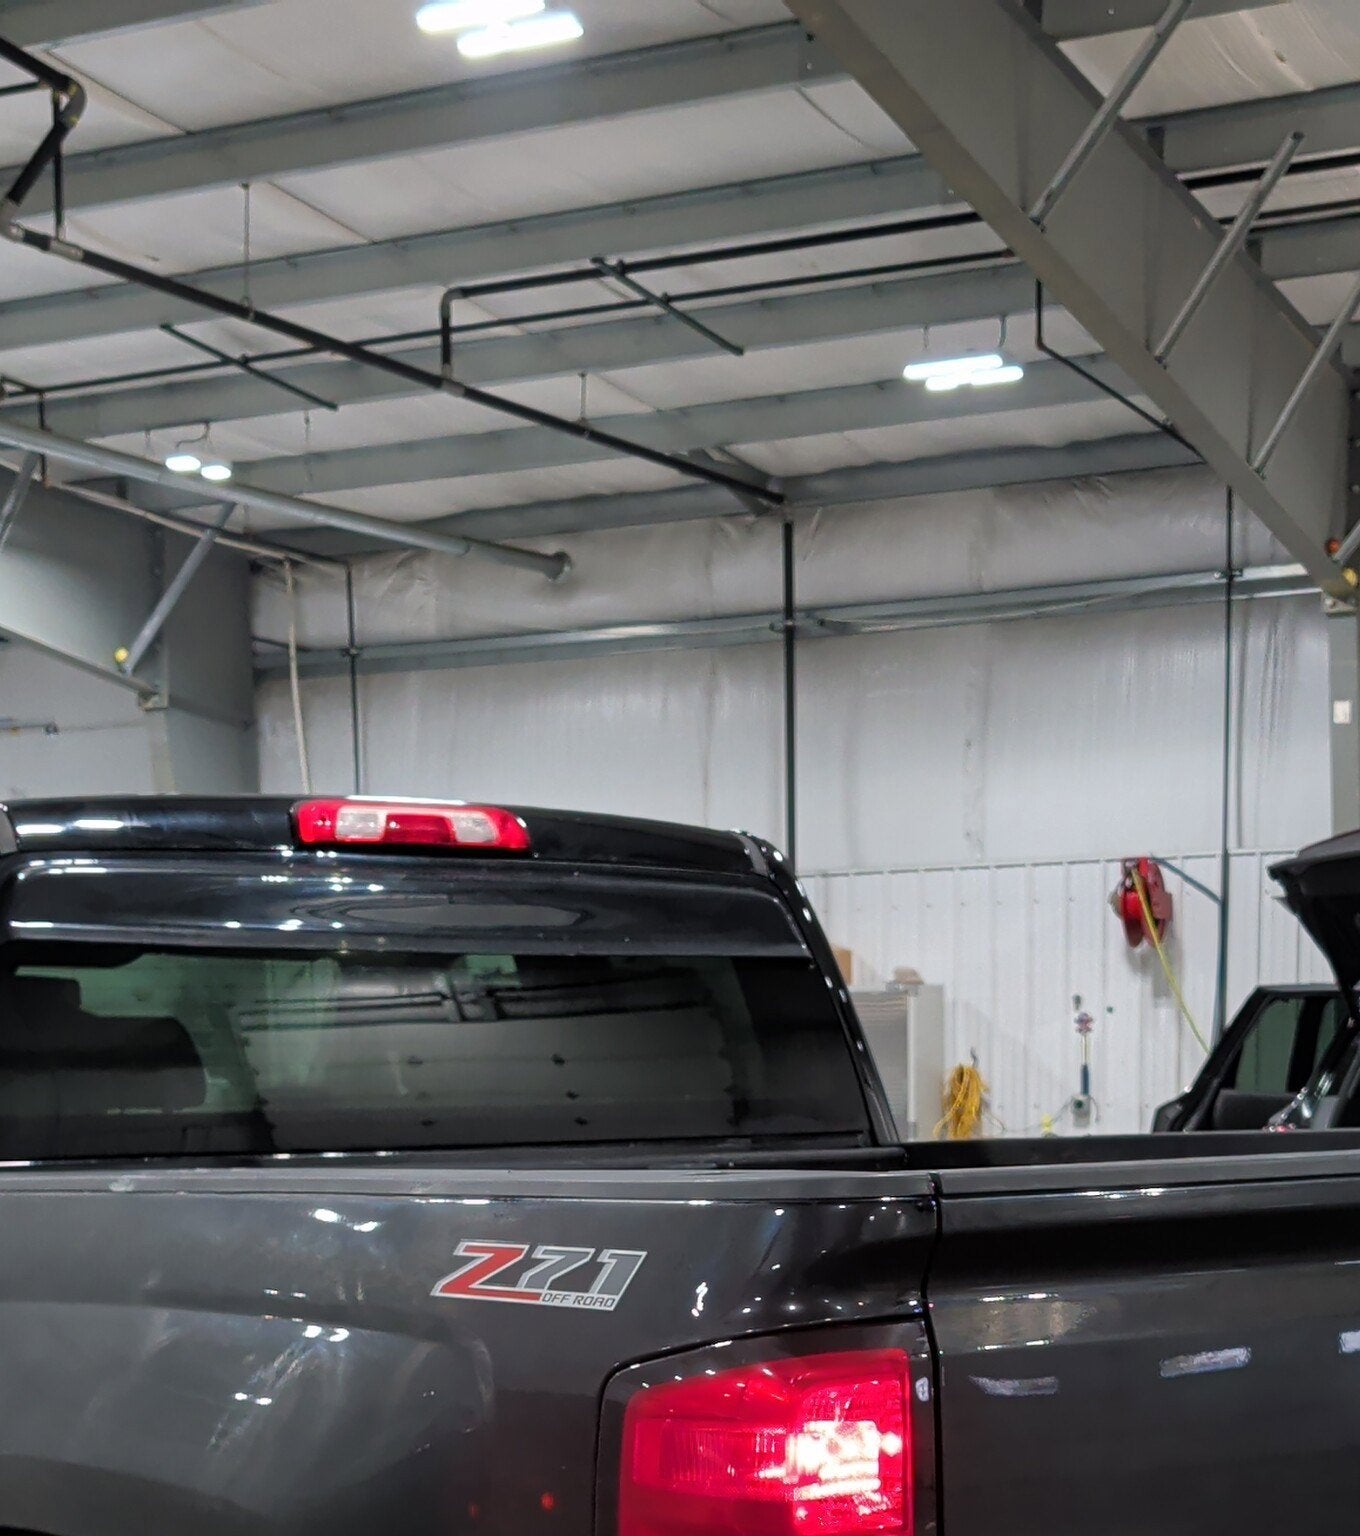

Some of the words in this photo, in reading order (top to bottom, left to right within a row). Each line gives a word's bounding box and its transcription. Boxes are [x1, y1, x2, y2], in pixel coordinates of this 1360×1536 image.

[430, 1239, 648, 1311] Z71
[541, 1292, 571, 1304] OFF
[572, 1294, 616, 1308] ROAD
